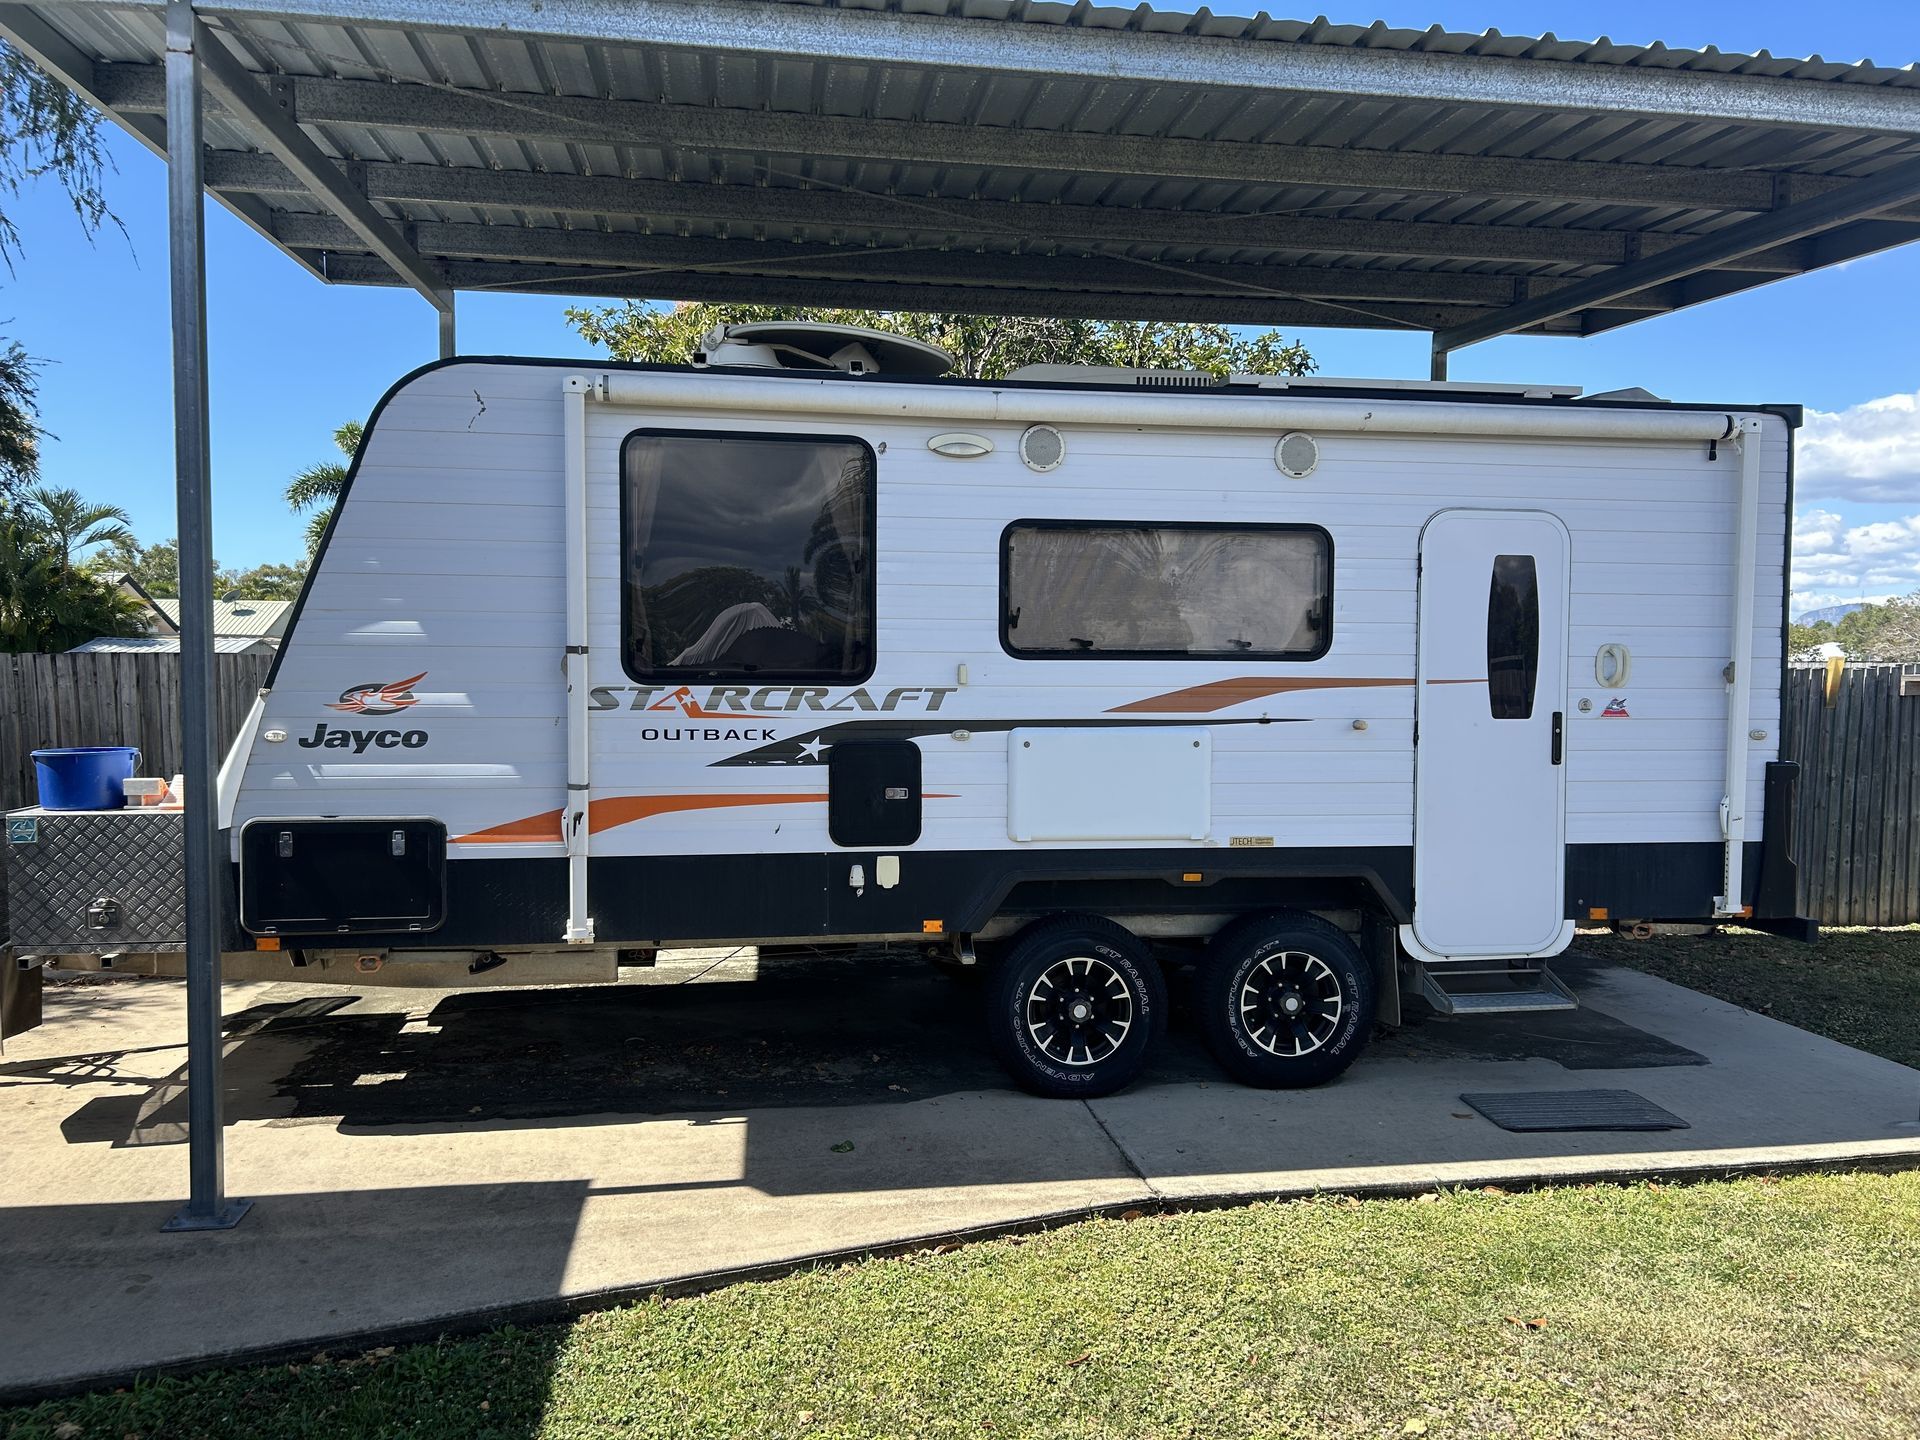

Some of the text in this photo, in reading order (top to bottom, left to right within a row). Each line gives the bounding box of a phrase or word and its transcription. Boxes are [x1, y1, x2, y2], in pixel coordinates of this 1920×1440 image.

[587, 686, 958, 718] STARCRAFT
[298, 723, 430, 755] Jayco
[641, 728, 777, 742] OUTBACK
[1095, 945, 1151, 1015] GT RADIAL
[1224, 957, 1258, 1058] ADVENTURO
[1012, 1016, 1095, 1082] ADVENTURO
[1330, 1001, 1360, 1056] RADIAL
